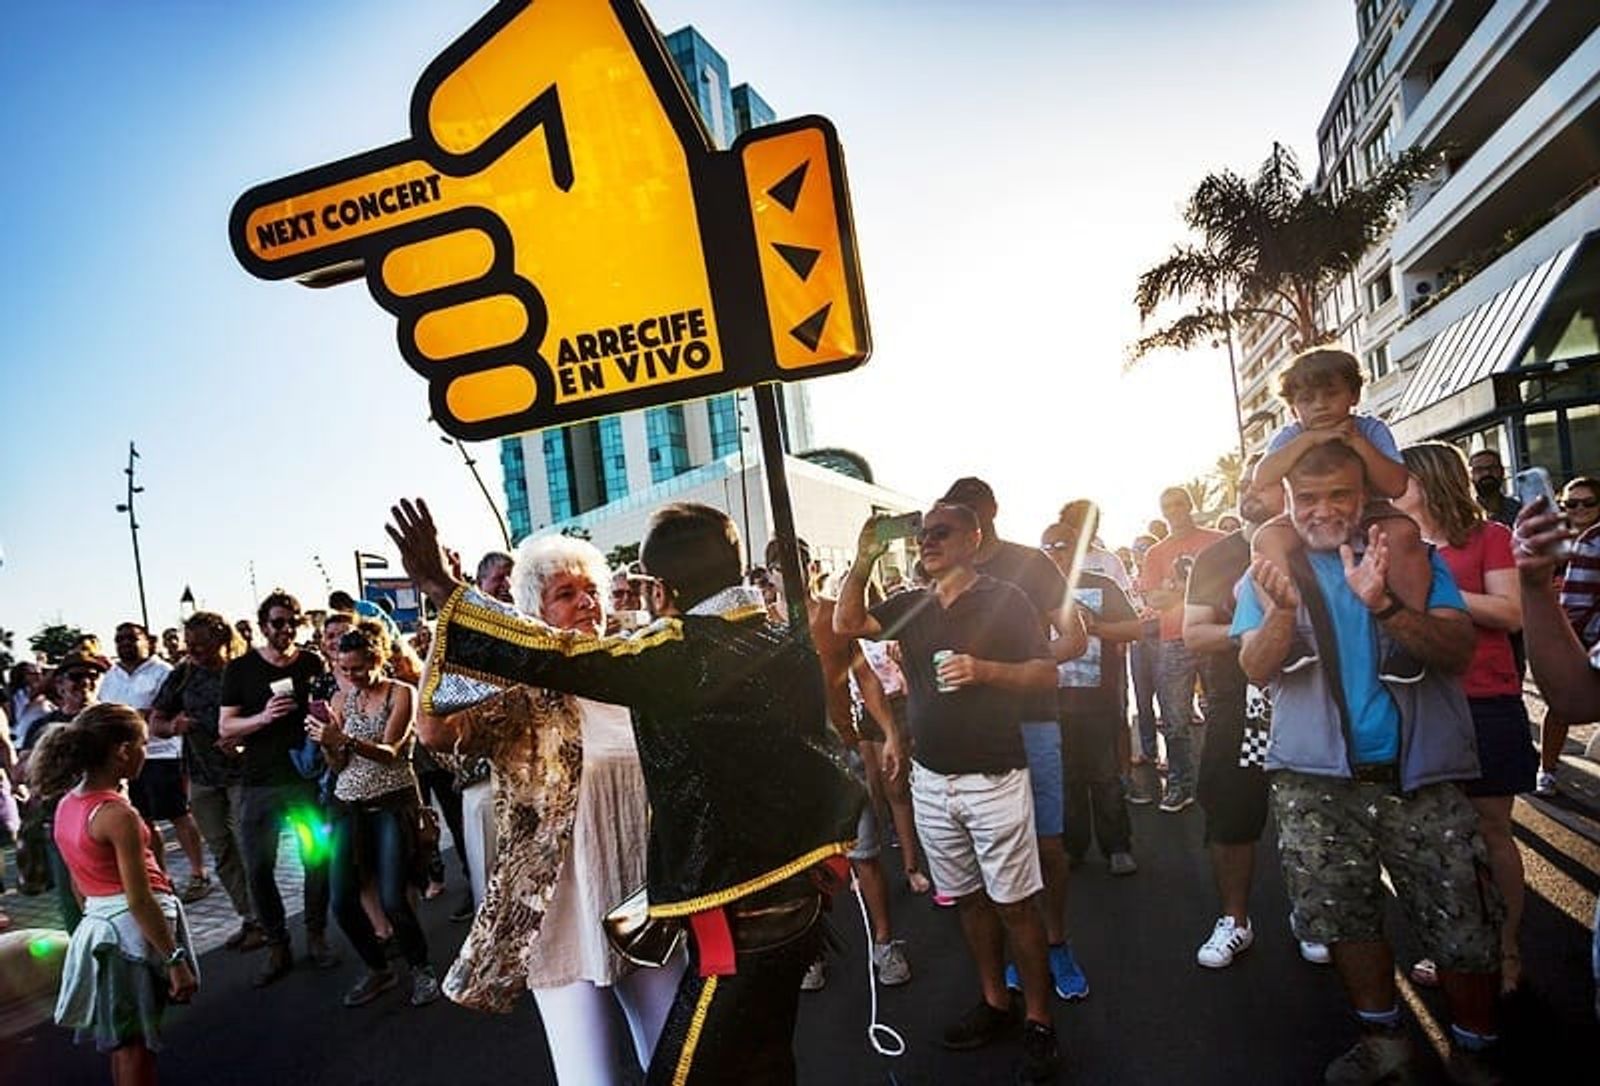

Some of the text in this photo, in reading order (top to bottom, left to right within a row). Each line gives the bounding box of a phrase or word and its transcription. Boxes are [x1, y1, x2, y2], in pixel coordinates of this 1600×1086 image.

[256, 174, 441, 249] NEXT CONCERT
[558, 308, 707, 366] ARRECIFE
[558, 340, 711, 395] EN VIVO
